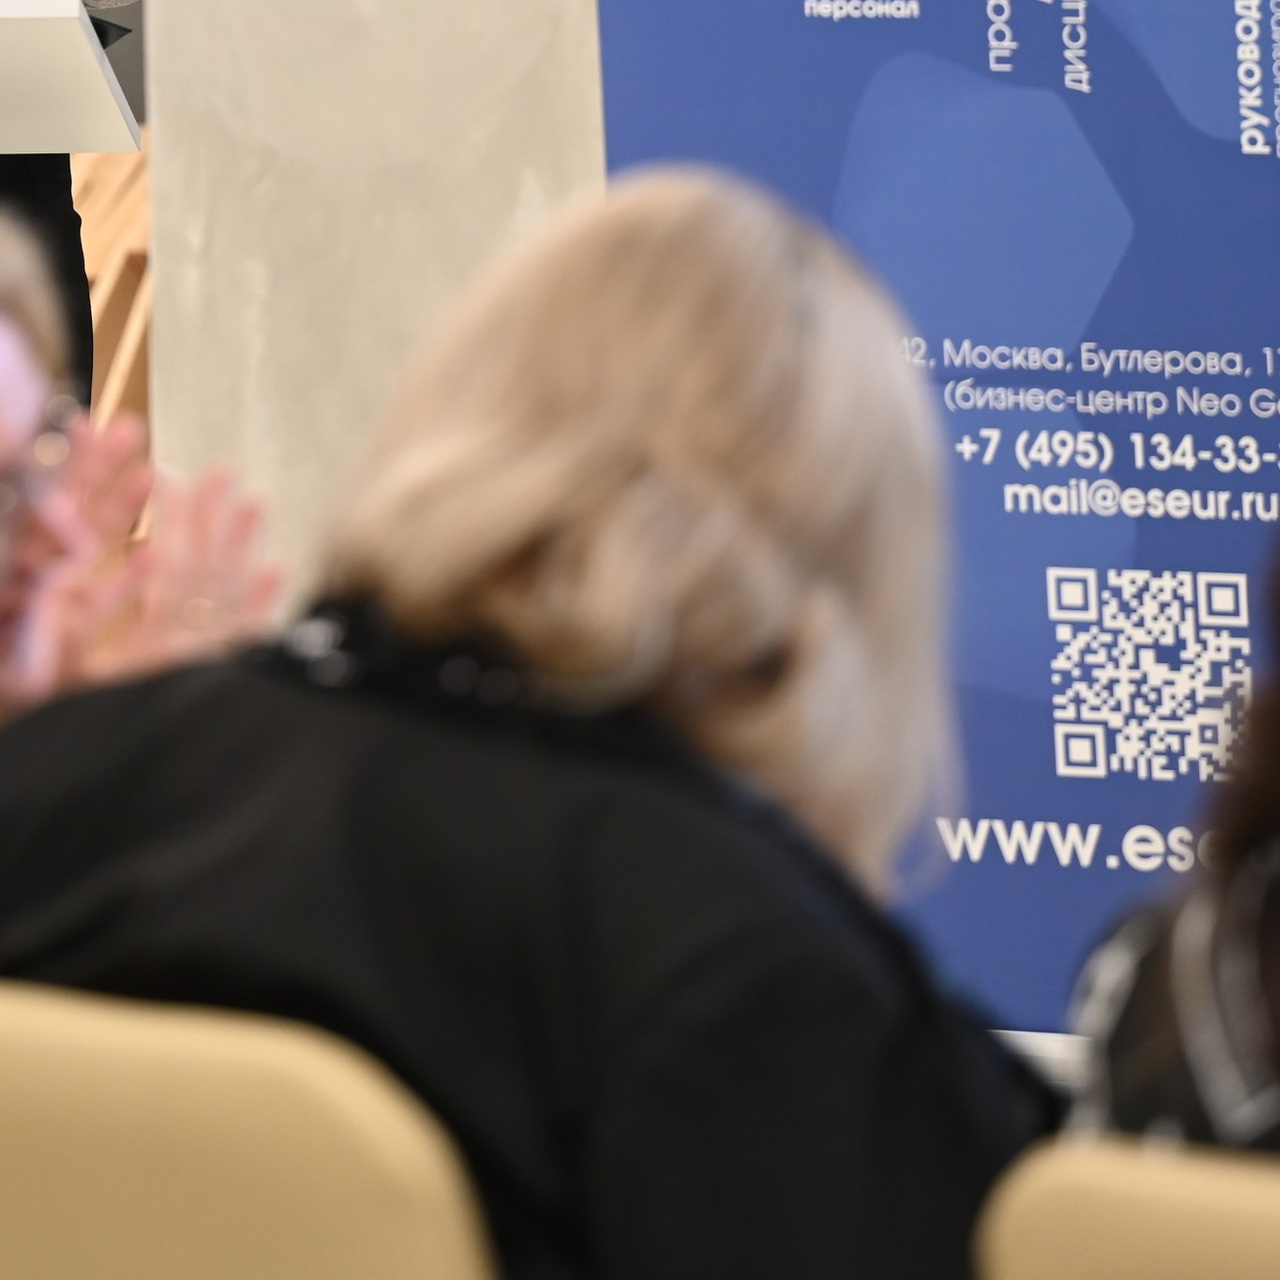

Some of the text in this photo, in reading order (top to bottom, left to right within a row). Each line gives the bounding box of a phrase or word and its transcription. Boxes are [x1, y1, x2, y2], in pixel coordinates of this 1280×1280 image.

[942, 338, 1074, 373] Москва,
[1080, 342, 1252, 379] Бутлерова,
[944, 377, 1280, 420] (бизнес-центр Neo G
[954, 427, 1280, 474] +7 (495) 134-33-
[1003, 478, 1280, 522] mail@eseur.ru
